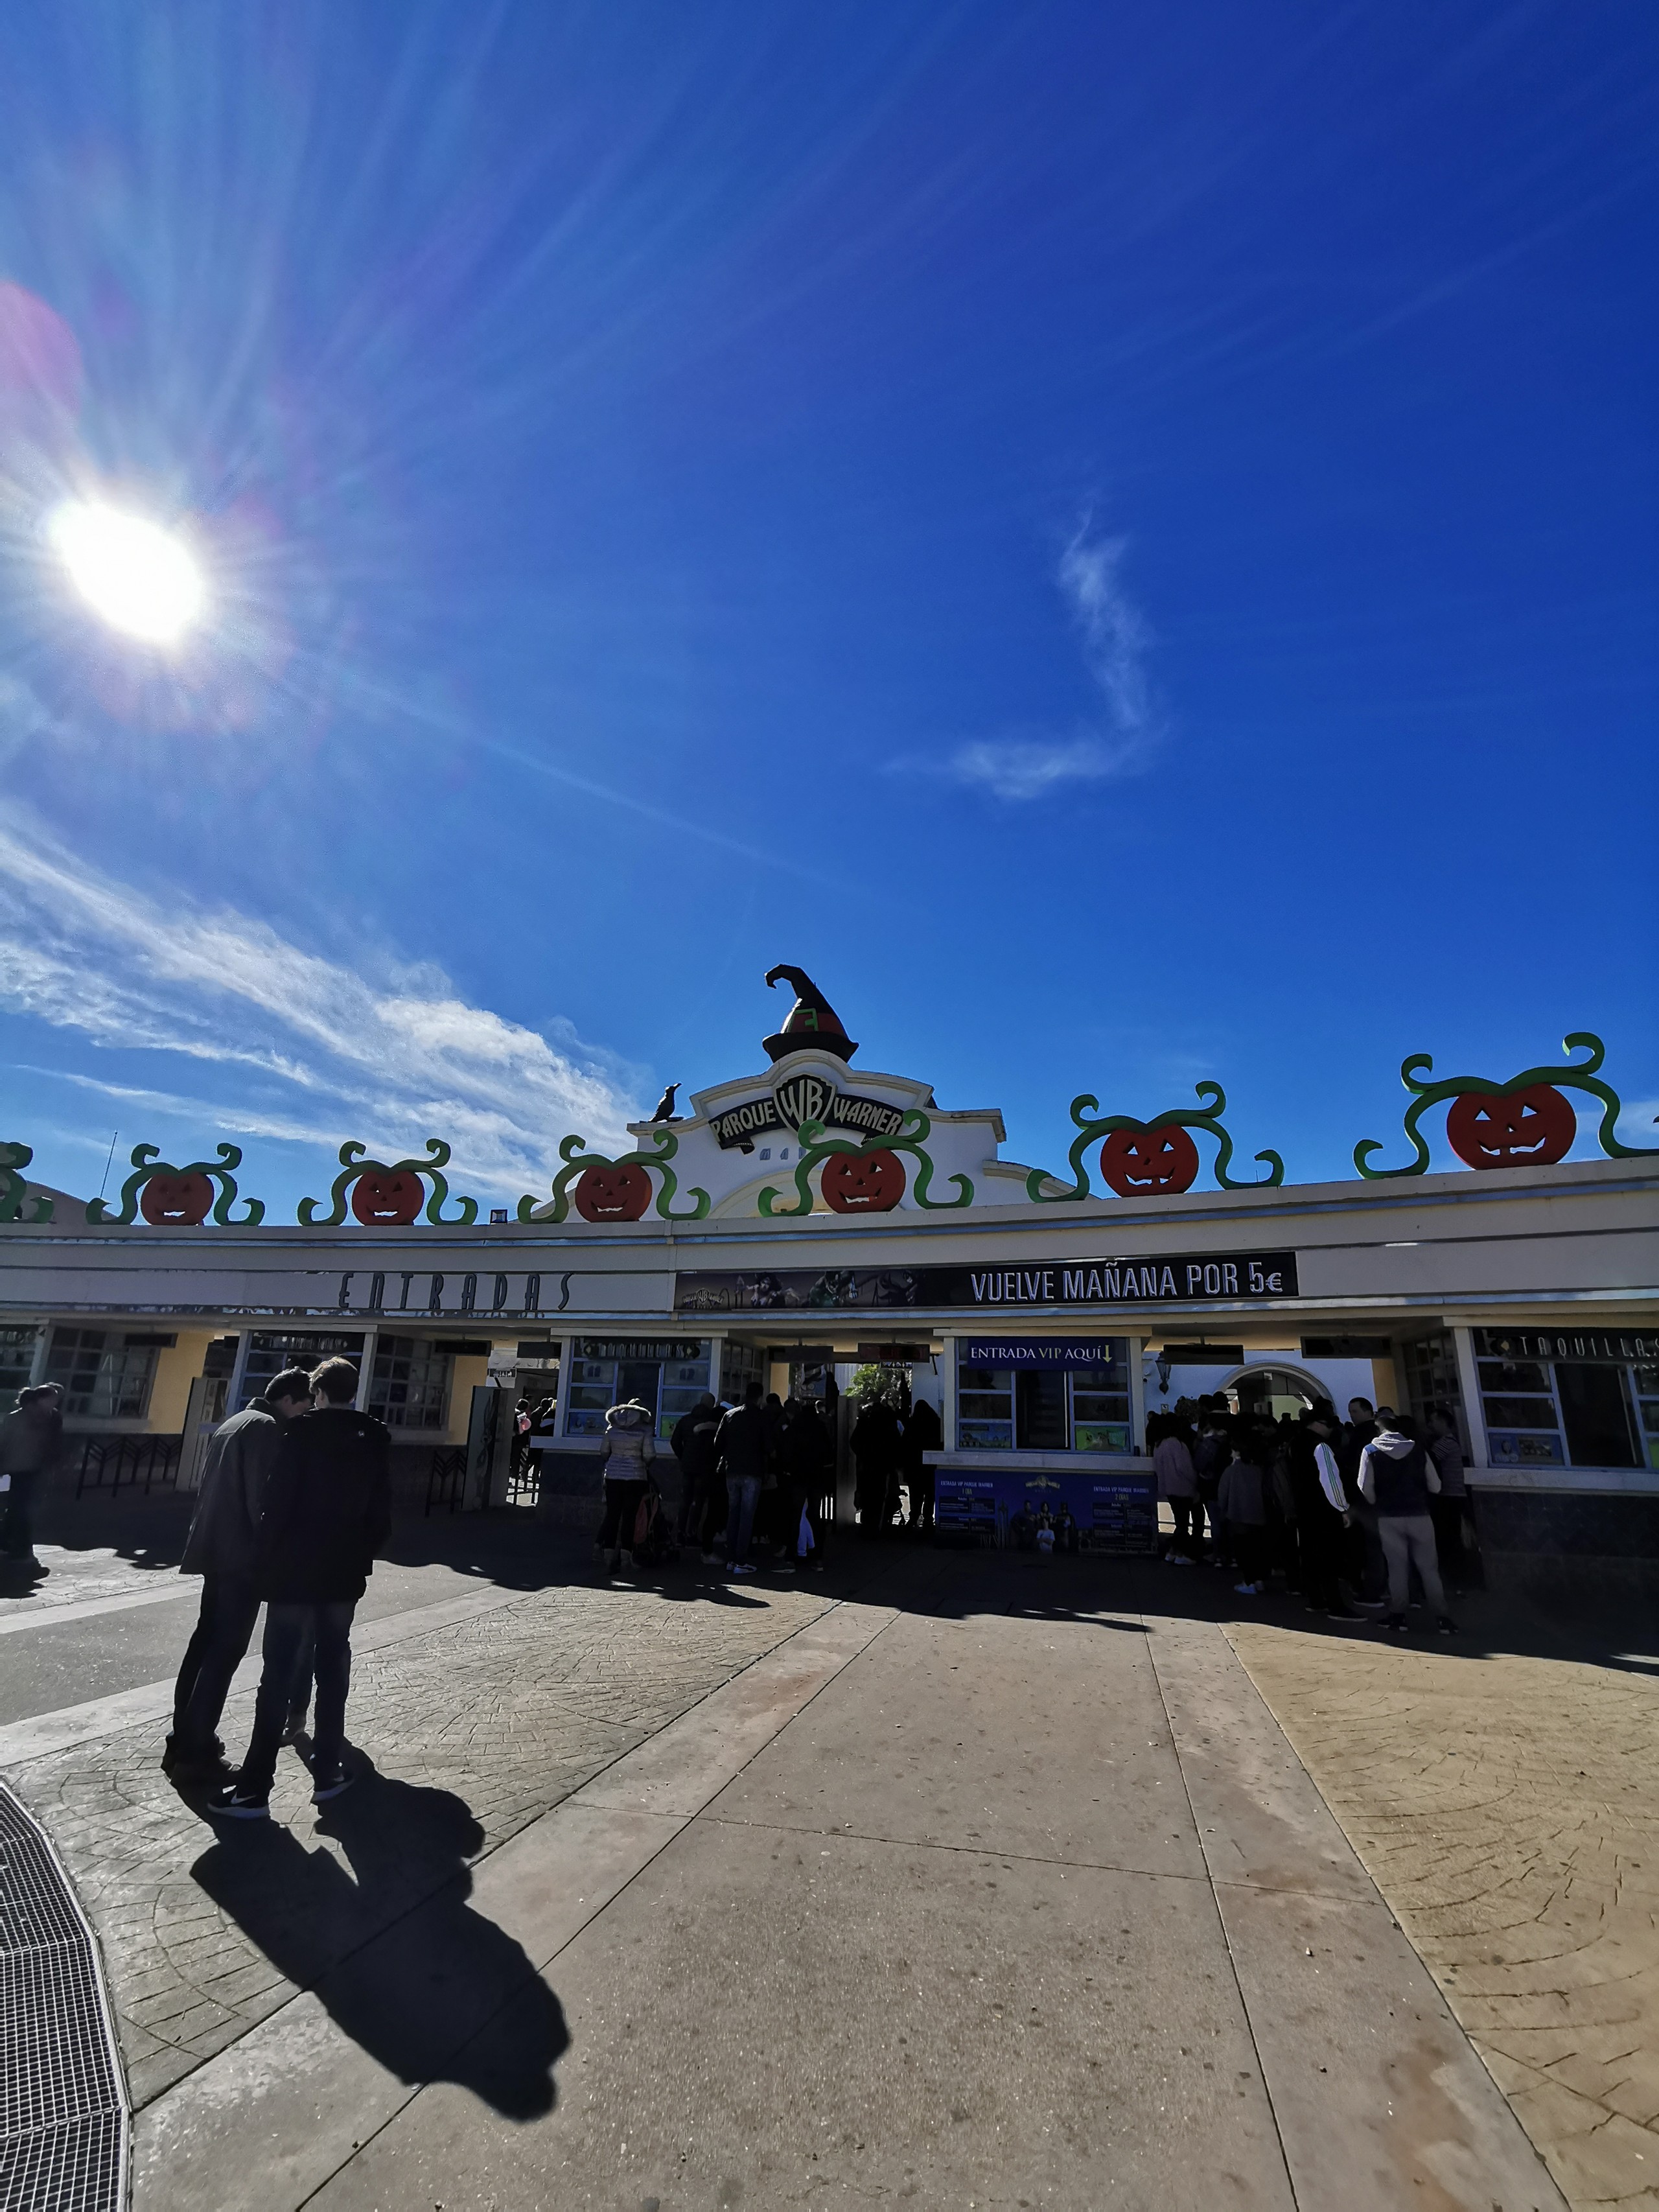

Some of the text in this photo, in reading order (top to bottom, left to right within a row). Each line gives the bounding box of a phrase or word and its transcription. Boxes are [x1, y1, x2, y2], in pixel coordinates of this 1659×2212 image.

[710, 1078, 903, 1143] PARQUE WB WARNER
[339, 1271, 574, 1311] ENTRADAS
[971, 1261, 1283, 1302] VUELVE MAÑANA POR 5€
[971, 1344, 1104, 1360] ENTRADA VIP AQUÍ
